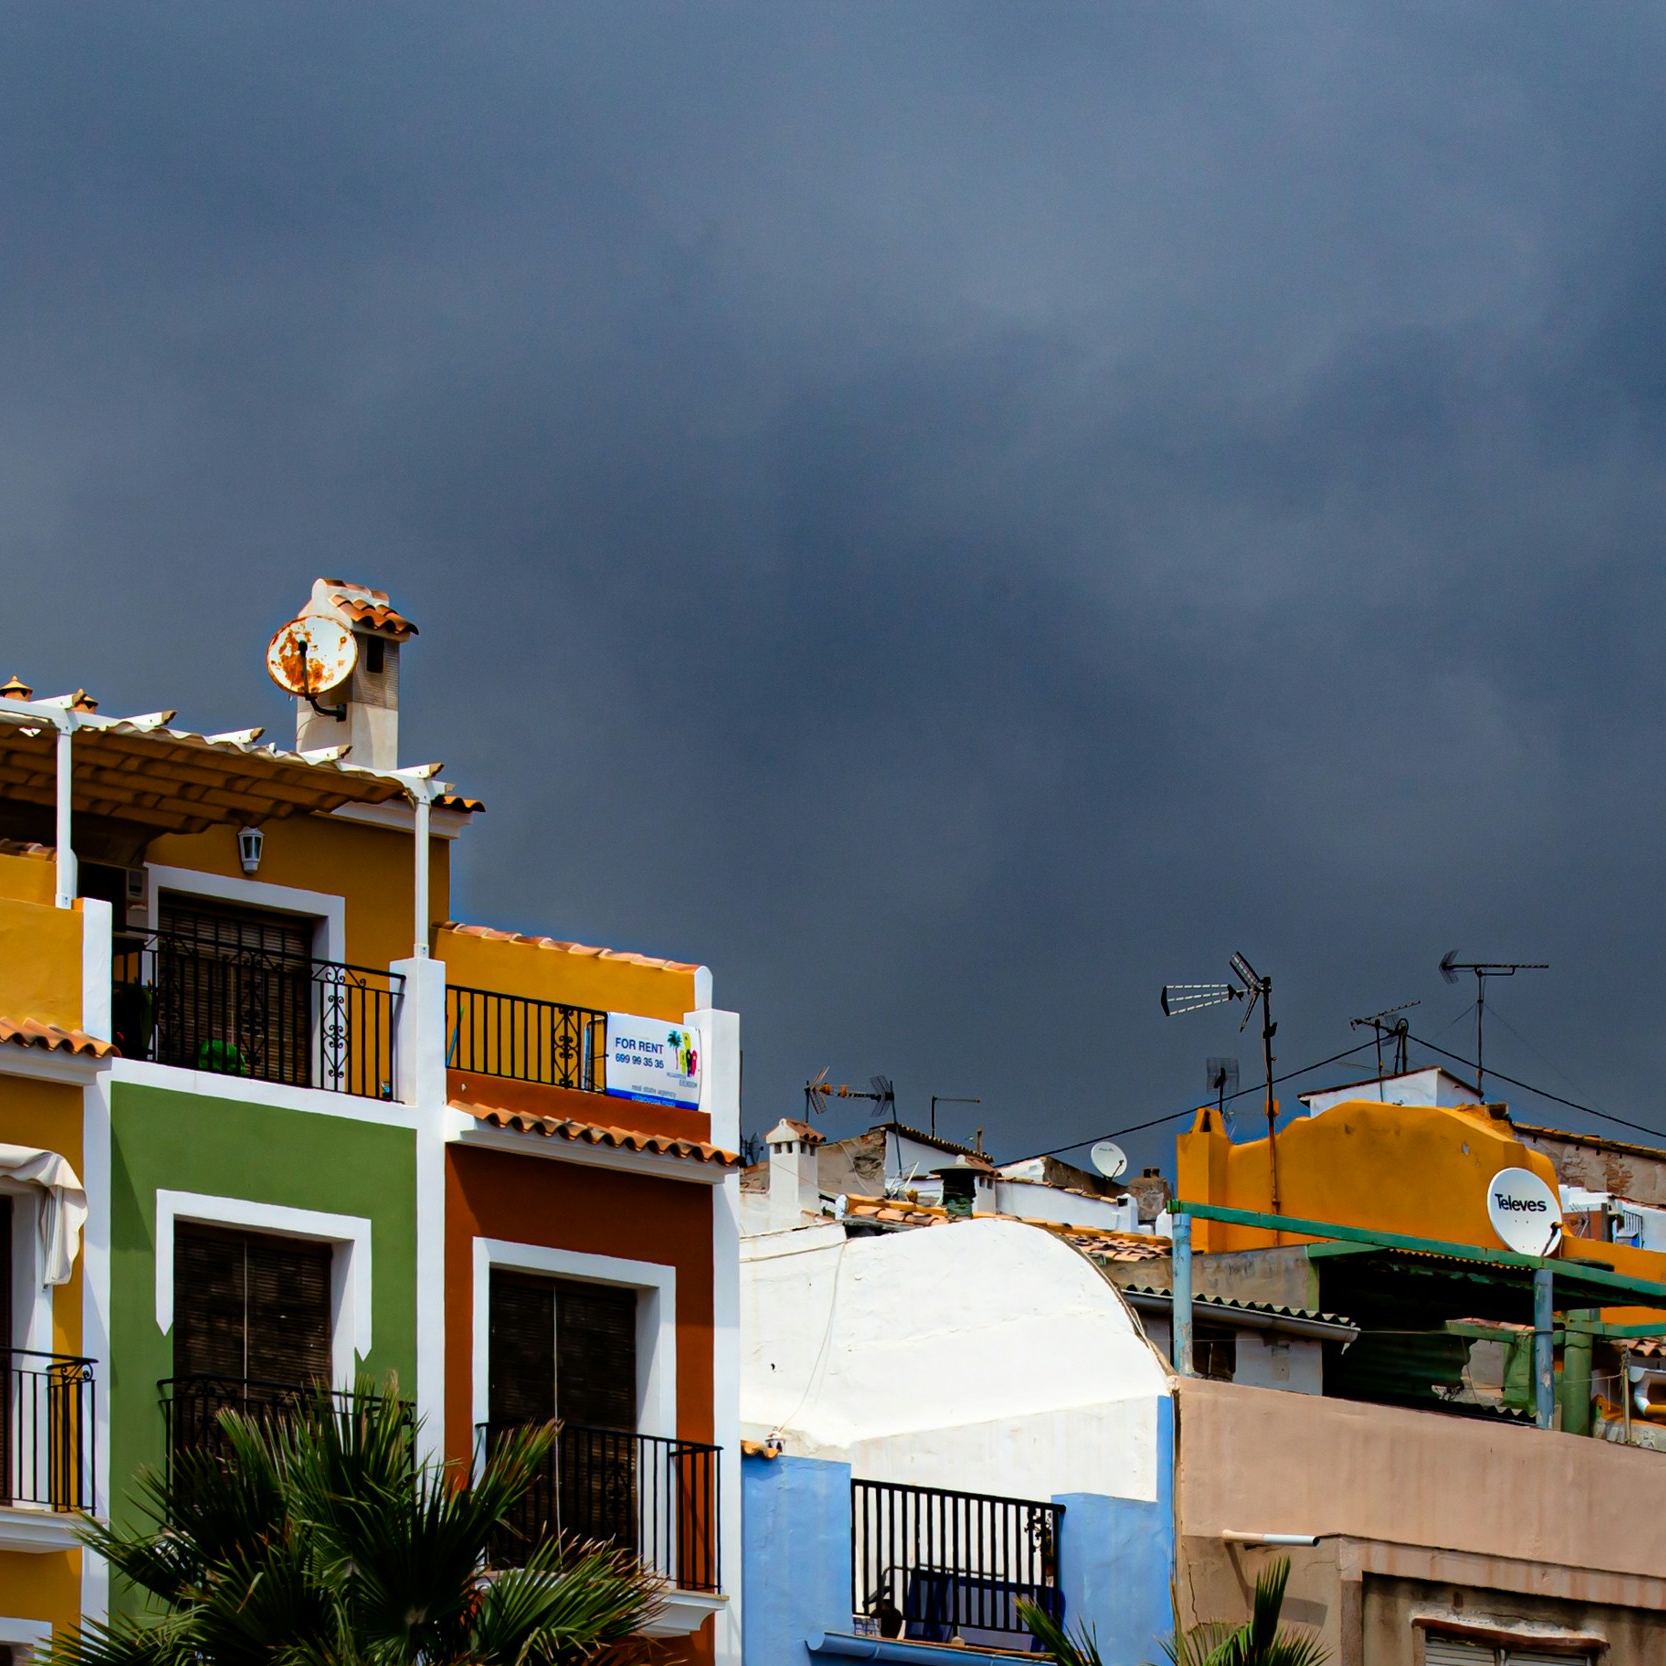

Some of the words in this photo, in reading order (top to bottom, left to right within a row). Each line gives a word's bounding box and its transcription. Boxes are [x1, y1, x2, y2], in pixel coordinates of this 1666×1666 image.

[615, 1037, 636, 1050] FOR
[638, 1041, 664, 1054] RENT
[615, 1053, 630, 1064] 699
[632, 1055, 642, 1065] 99
[643, 1057, 653, 1067] 35
[654, 1059, 664, 1069] 35
[1494, 1193, 1547, 1212] Televes
